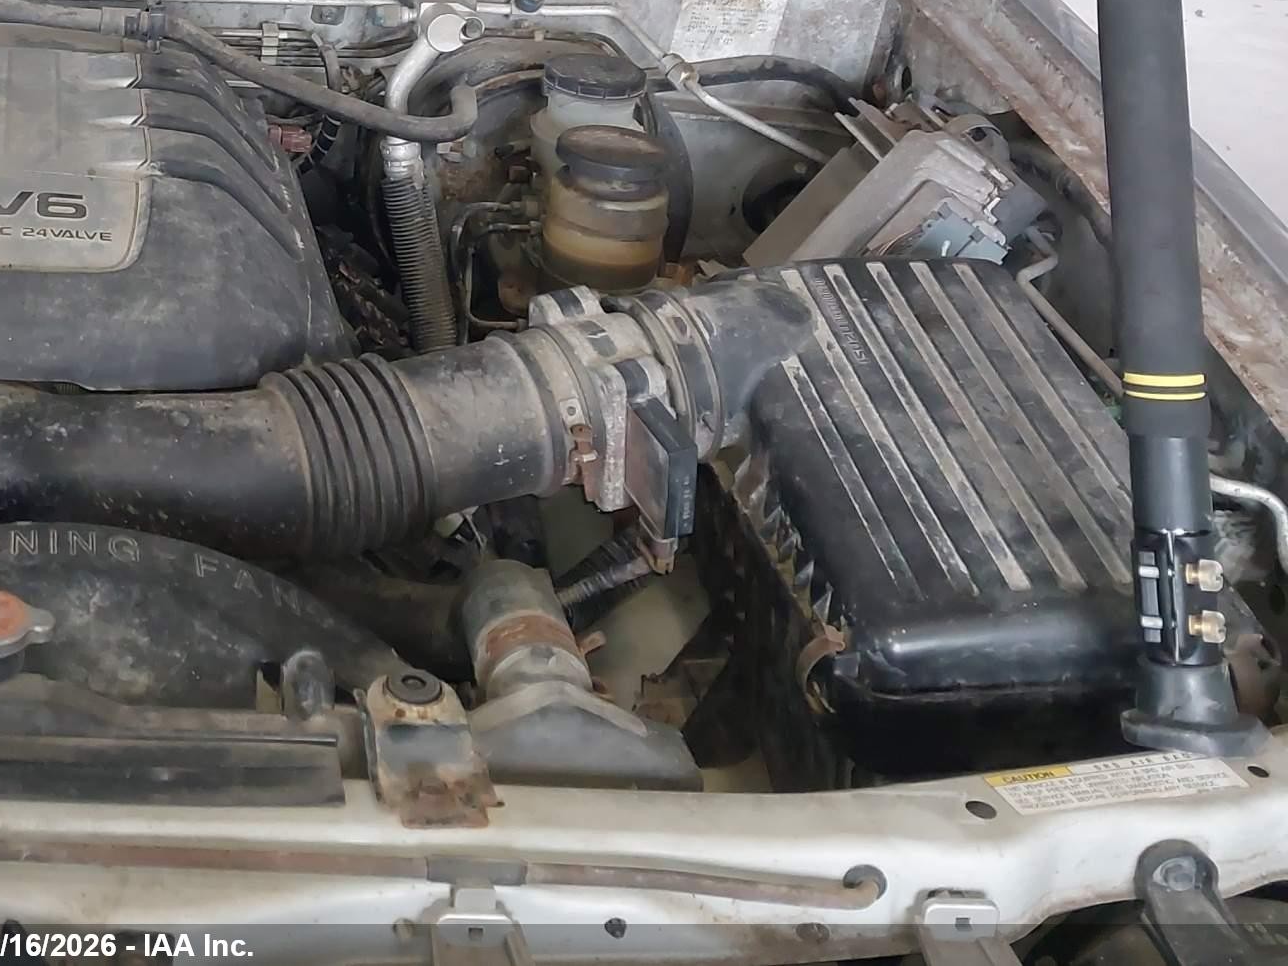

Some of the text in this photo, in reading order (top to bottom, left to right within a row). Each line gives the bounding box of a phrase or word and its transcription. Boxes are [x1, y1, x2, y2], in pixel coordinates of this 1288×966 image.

[194, 551, 304, 614] FAN
[1093, 762, 1121, 771] SRS
[1130, 757, 1153, 766] AIR
[1001, 770, 1055, 784] CAUTION
